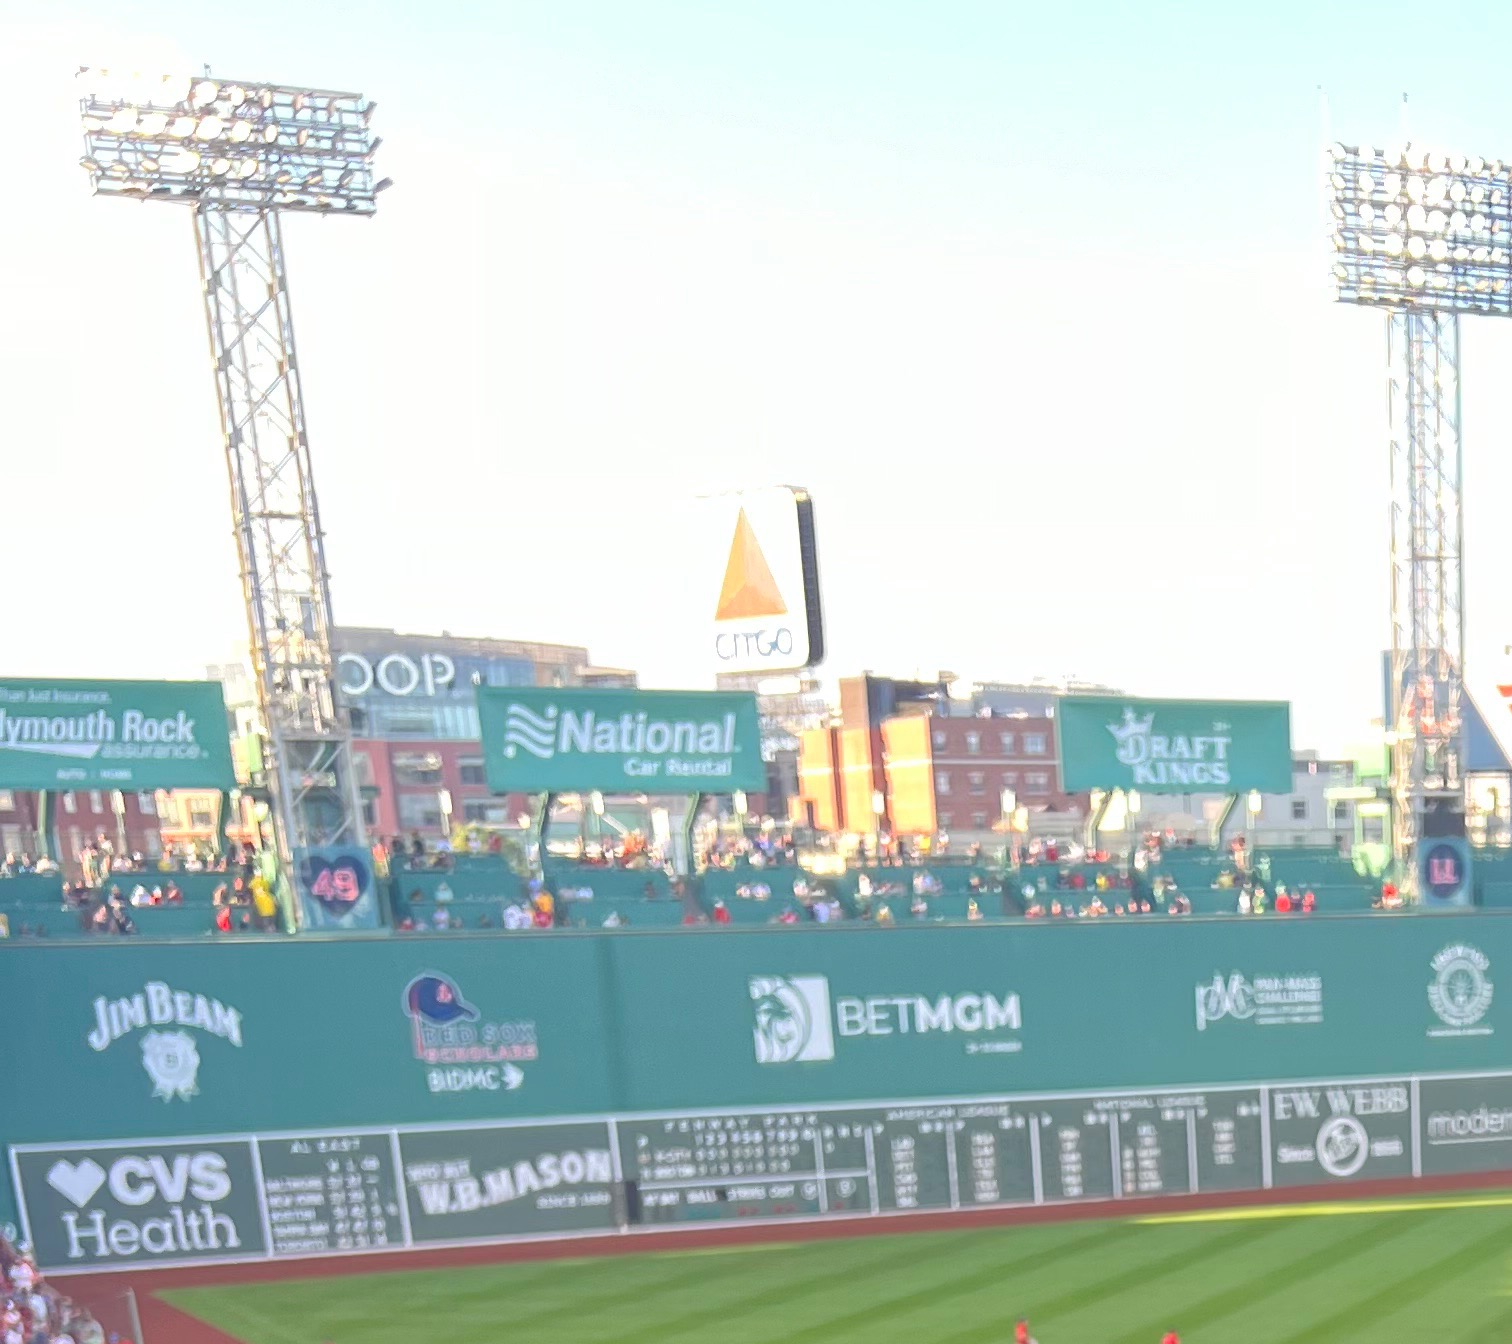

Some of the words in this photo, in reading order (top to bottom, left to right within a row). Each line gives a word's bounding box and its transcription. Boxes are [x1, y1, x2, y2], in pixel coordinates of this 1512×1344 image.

[715, 628, 793, 661] CITGO
[122, 709, 195, 743] Rock
[558, 711, 739, 754] National
[1116, 735, 1232, 765] DRAFT
[624, 758, 659, 776] Car
[666, 758, 732, 776] Rental
[1133, 761, 1231, 785] KINGS
[311, 868, 359, 901] 49
[88, 994, 146, 1052] JIM
[146, 979, 244, 1048] BEAM
[836, 991, 1022, 1036] BETMGM
[428, 1065, 501, 1093] BIDMC
[1325, 1087, 1410, 1116] WEBB
[108, 1151, 232, 1206] CVS
[60, 1203, 242, 1258] Health
